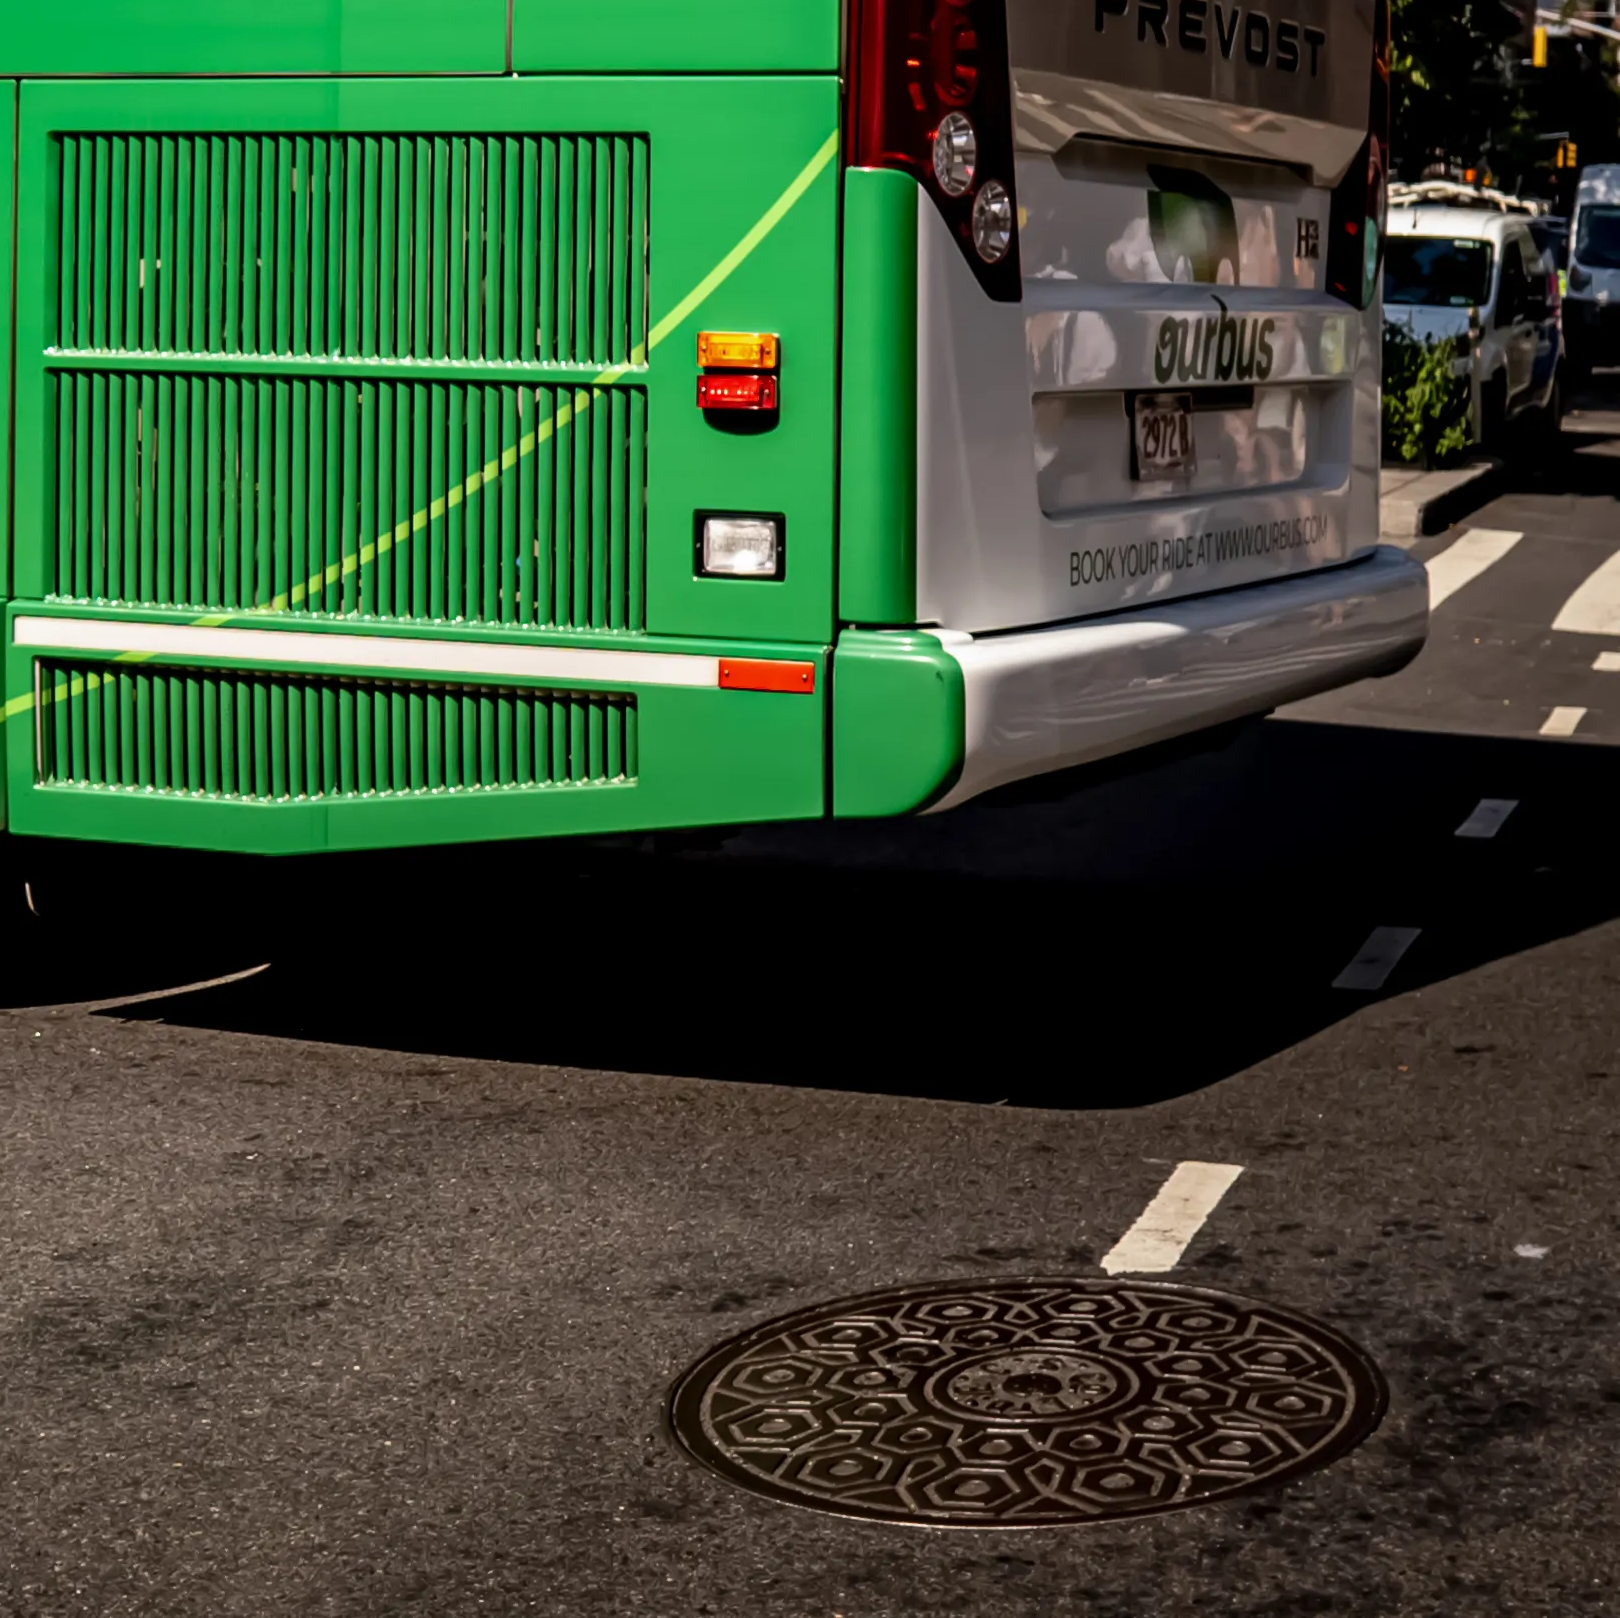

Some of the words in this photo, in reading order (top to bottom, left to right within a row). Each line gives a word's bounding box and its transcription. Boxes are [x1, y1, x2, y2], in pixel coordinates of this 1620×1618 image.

[1155, 293, 1276, 384] ourbus
[1069, 547, 1116, 587] BOOK
[1118, 541, 1159, 578] YOUR
[1162, 535, 1194, 572] RIDE
[1196, 532, 1214, 566] AT
[1216, 514, 1329, 564] WWW.OURBUS.COM
